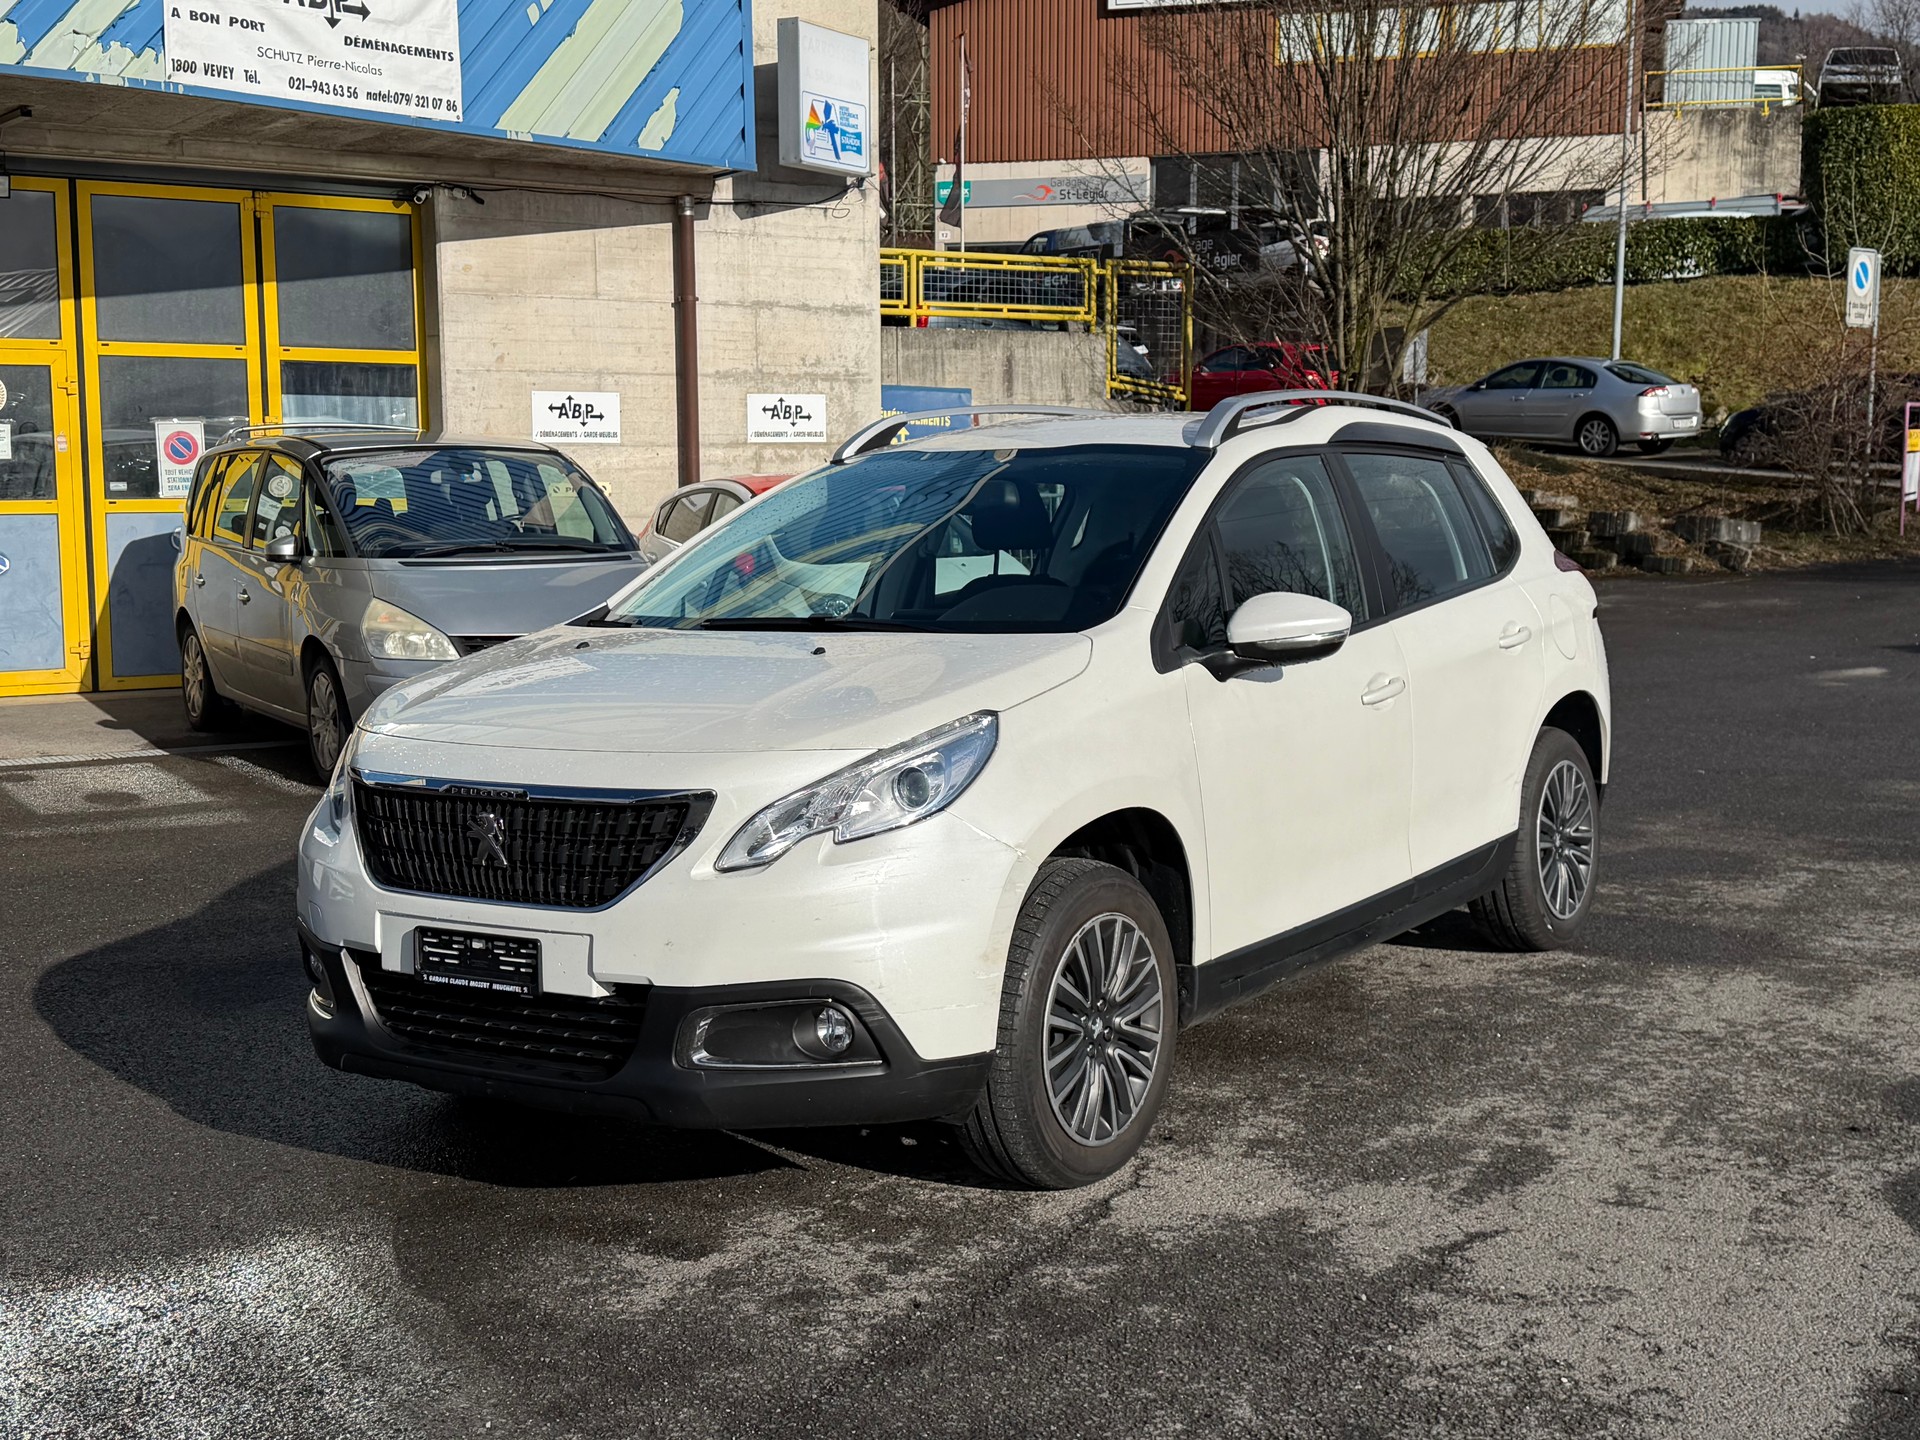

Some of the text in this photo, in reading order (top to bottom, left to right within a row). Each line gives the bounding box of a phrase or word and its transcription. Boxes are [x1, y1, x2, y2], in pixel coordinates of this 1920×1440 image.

[171, 7, 266, 33] A BON PORT
[344, 35, 455, 62] DÉMÉNAGEMENTS
[257, 46, 383, 76] SCHUTZ Pierre-Nicolas
[171, 58, 197, 74] 1800
[203, 62, 234, 80] VEVEY
[244, 69, 261, 85] Tél.
[414, 95, 430, 109] 321
[432, 97, 443, 111] 07
[446, 99, 458, 113] 86
[558, 403, 594, 419] ABP
[770, 404, 803, 420] ABP
[451, 787, 516, 799] PEUGEOT
[428, 975, 448, 984] GARAGE
[450, 977, 469, 987] CLAUDE
